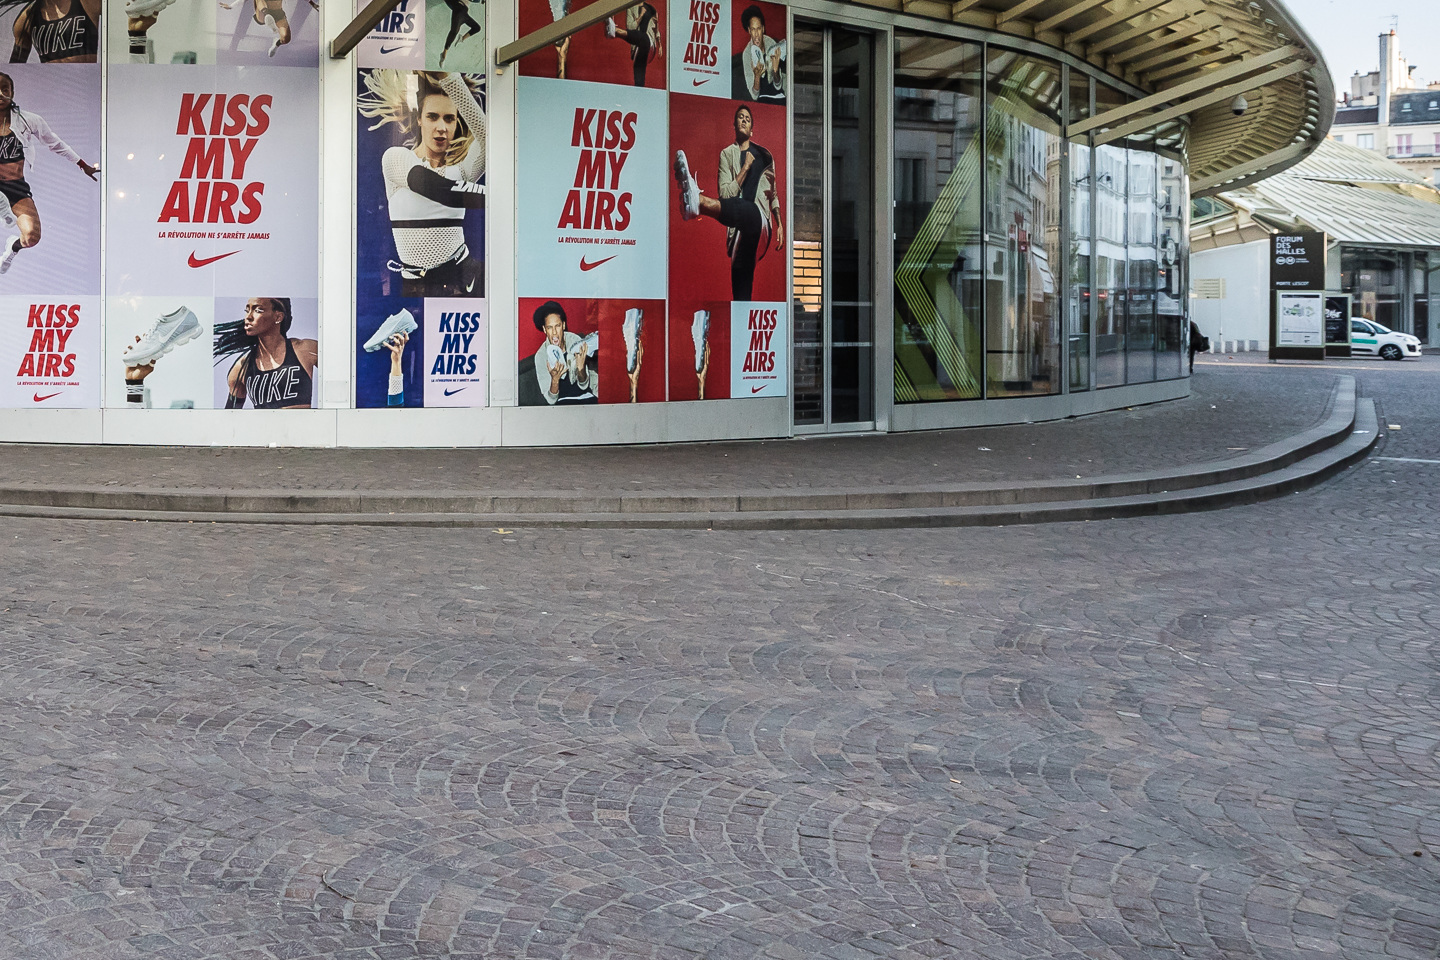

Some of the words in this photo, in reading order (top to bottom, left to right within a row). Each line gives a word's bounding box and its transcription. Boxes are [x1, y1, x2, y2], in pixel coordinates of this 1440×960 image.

[689, 0, 721, 23] KISS
[32, 16, 85, 55] NIKE
[690, 22, 716, 45] MY
[683, 43, 718, 67] AIRS
[176, 93, 273, 137] KISS
[571, 108, 637, 151] KISS
[179, 138, 259, 179] MY
[574, 149, 628, 190] MY
[157, 181, 265, 224] AIRS
[557, 189, 632, 231] AIRS
[168, 230, 206, 238] RÉVOLUTION
[216, 231, 245, 239] S'ARRÊTE
[27, 304, 81, 328] KISS
[439, 312, 480, 333] KISS
[748, 309, 778, 330] KISS
[29, 329, 73, 352] MY
[440, 334, 474, 353] MY
[749, 330, 774, 351] MY
[17, 353, 76, 377] AIRS
[431, 354, 477, 375] AIRS
[743, 351, 775, 372] AIRS
[246, 366, 300, 405] NIKE
